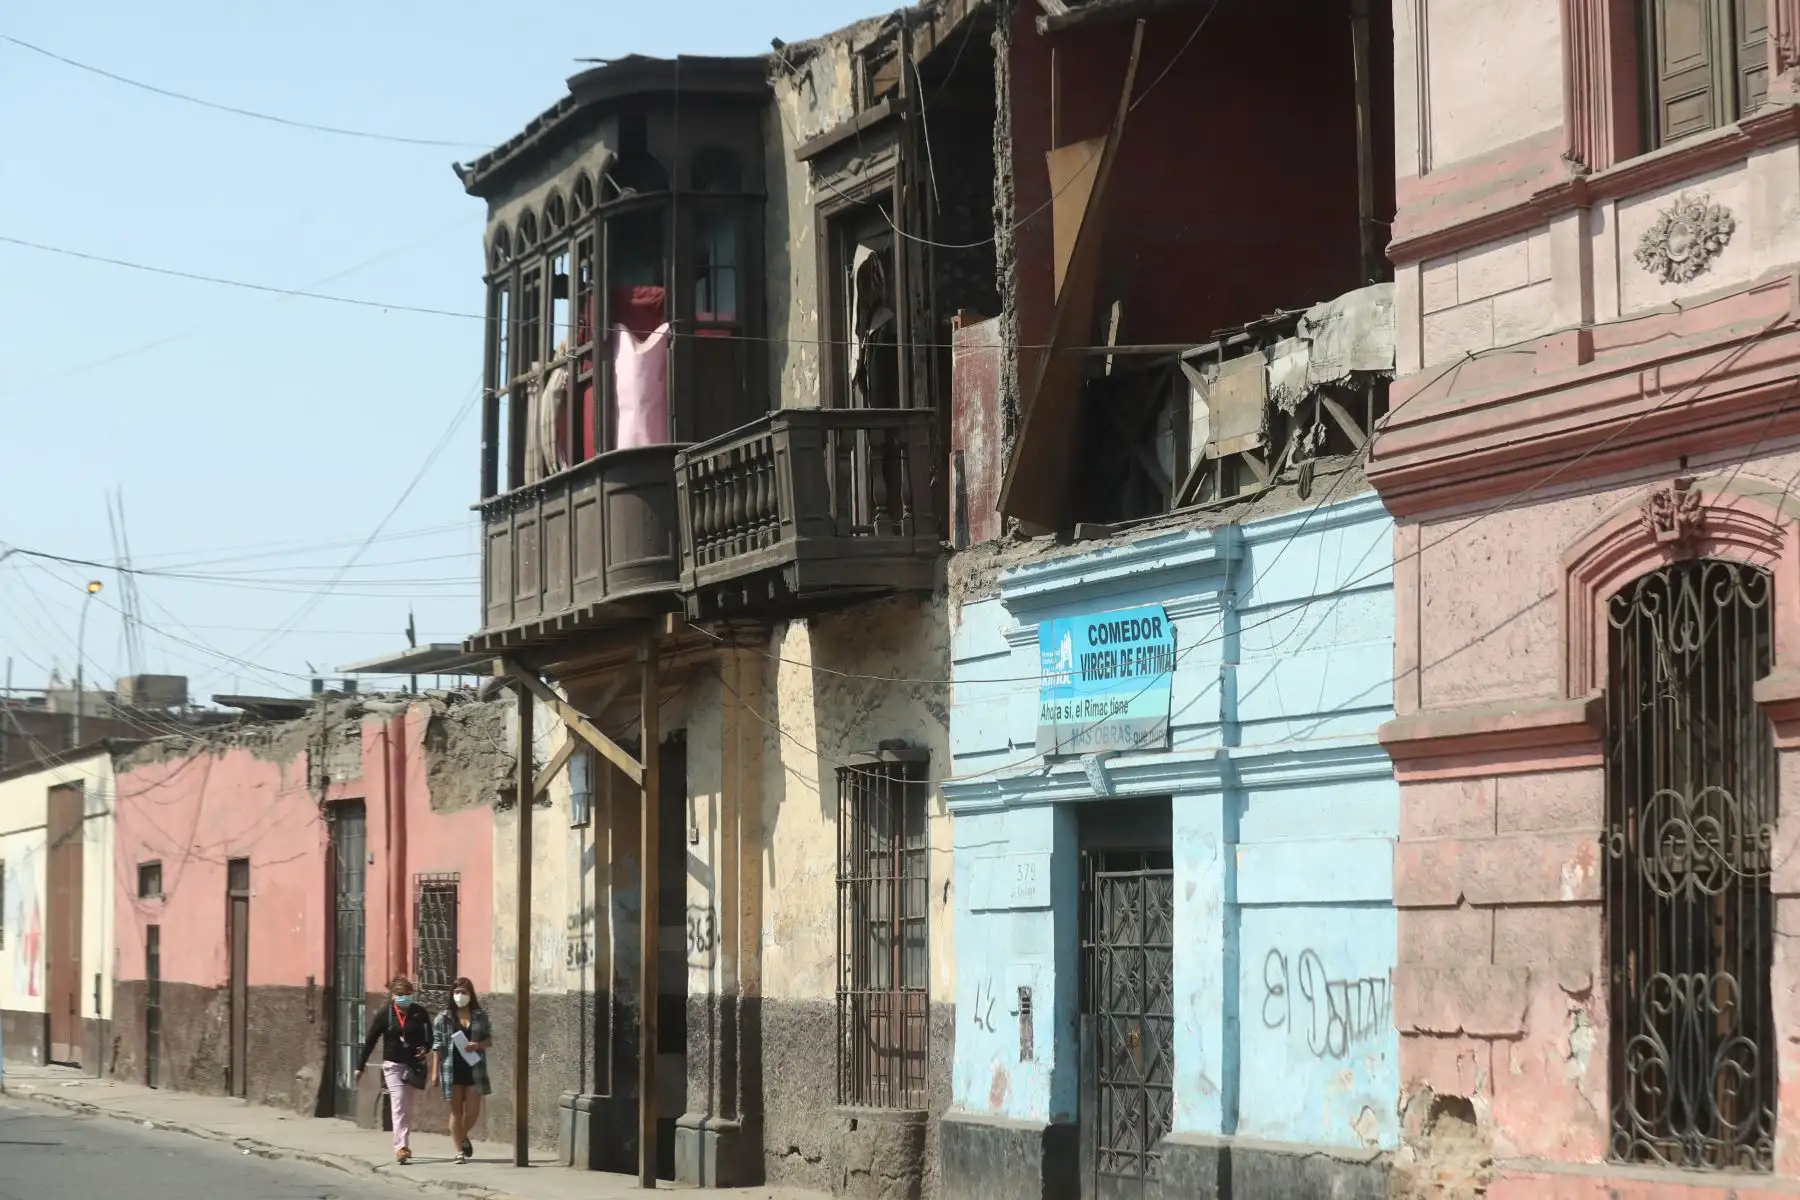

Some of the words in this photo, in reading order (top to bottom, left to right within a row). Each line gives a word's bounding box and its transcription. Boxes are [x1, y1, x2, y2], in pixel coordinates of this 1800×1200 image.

[1088, 616, 1163, 646] COMEDOR
[1080, 651, 1118, 682] VIRGEN
[1120, 649, 1133, 678] DE
[1136, 644, 1173, 676] FATIMA
[1076, 700, 1083, 718] el
[1110, 696, 1129, 715] tiene
[1094, 724, 1131, 746] OBRAS
[1133, 730, 1147, 747] que
